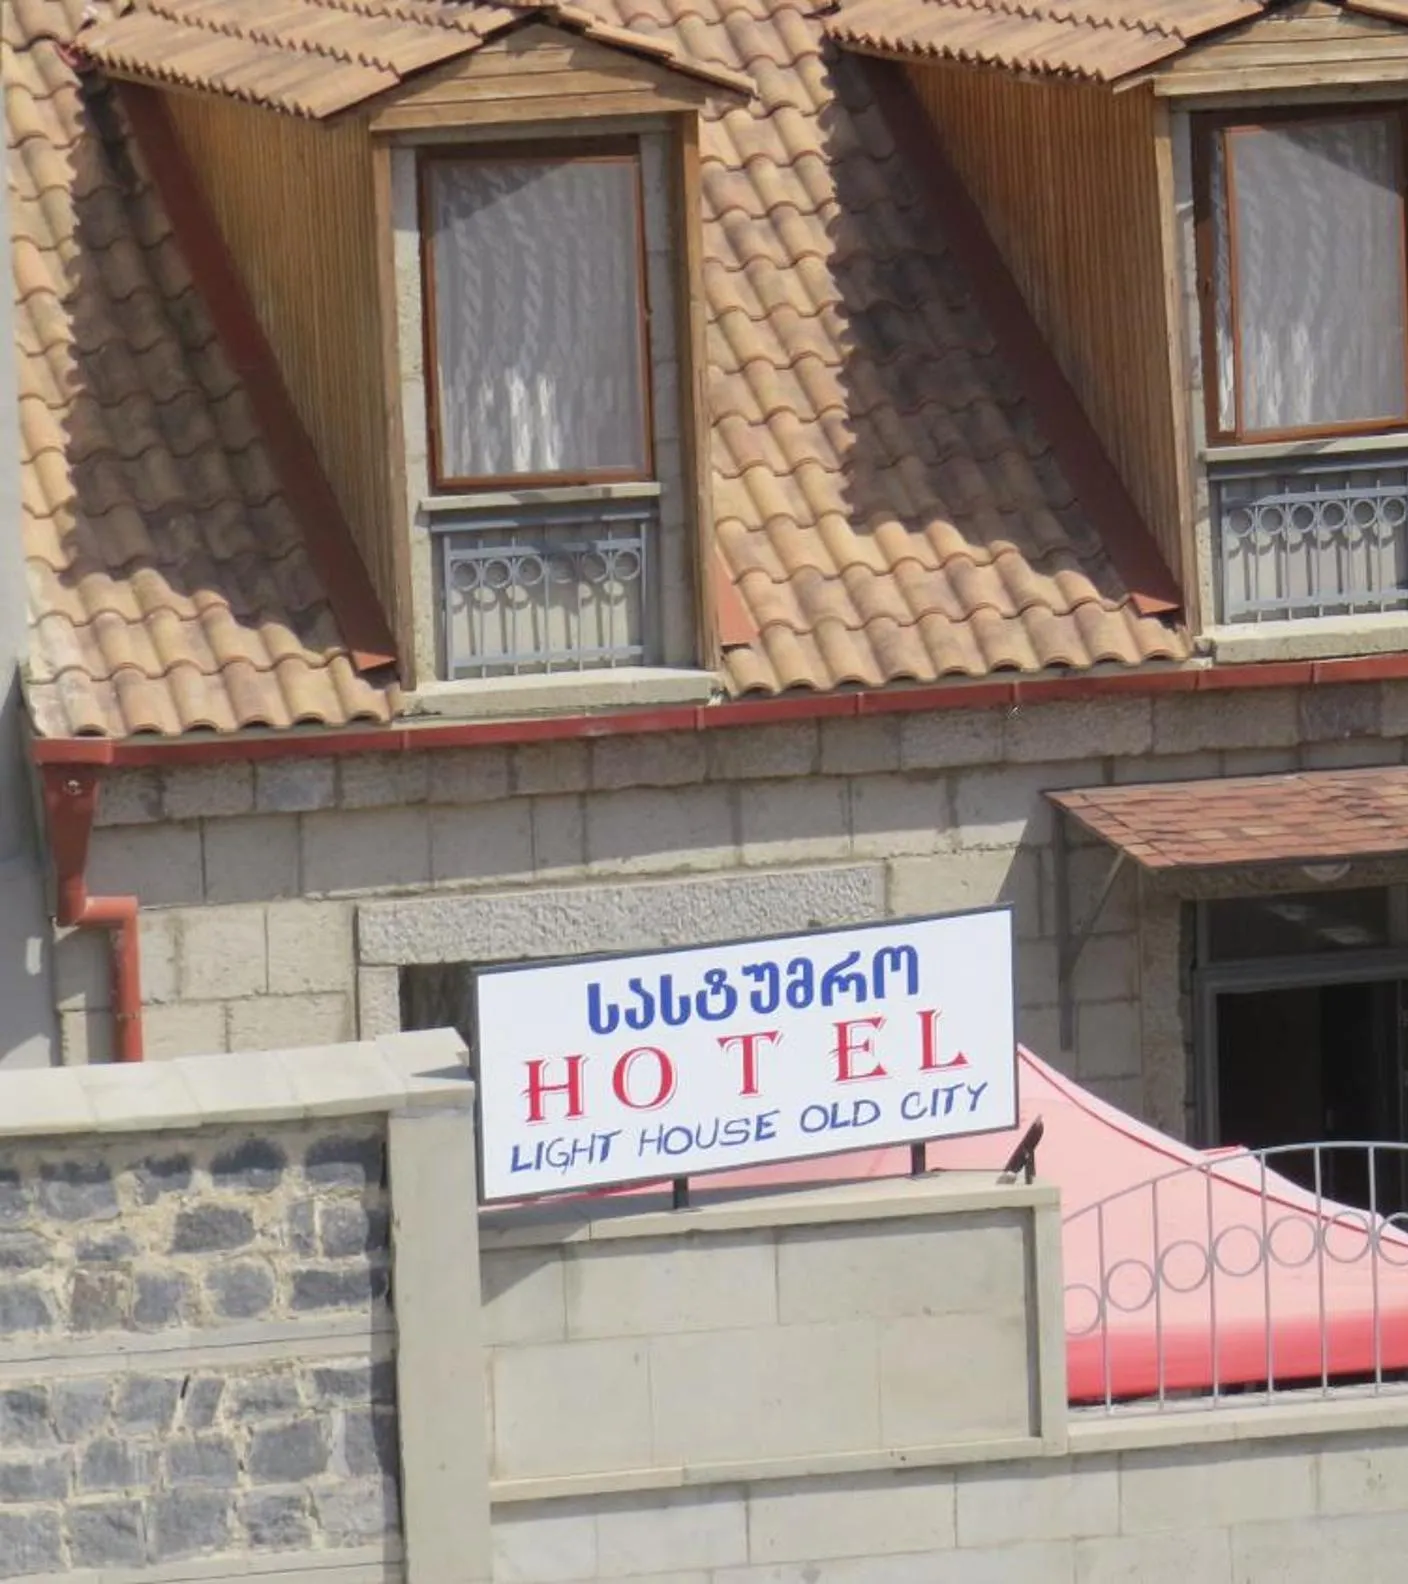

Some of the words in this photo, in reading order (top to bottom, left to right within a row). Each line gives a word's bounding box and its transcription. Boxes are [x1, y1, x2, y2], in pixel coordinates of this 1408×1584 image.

[587, 944, 919, 1035] სასტუმრო
[521, 1008, 969, 1124] HOTEL
[511, 1129, 620, 1175] LIGHT
[638, 1110, 780, 1158] HOUSE
[800, 1098, 881, 1133] OLD
[900, 1081, 988, 1120] CITY
